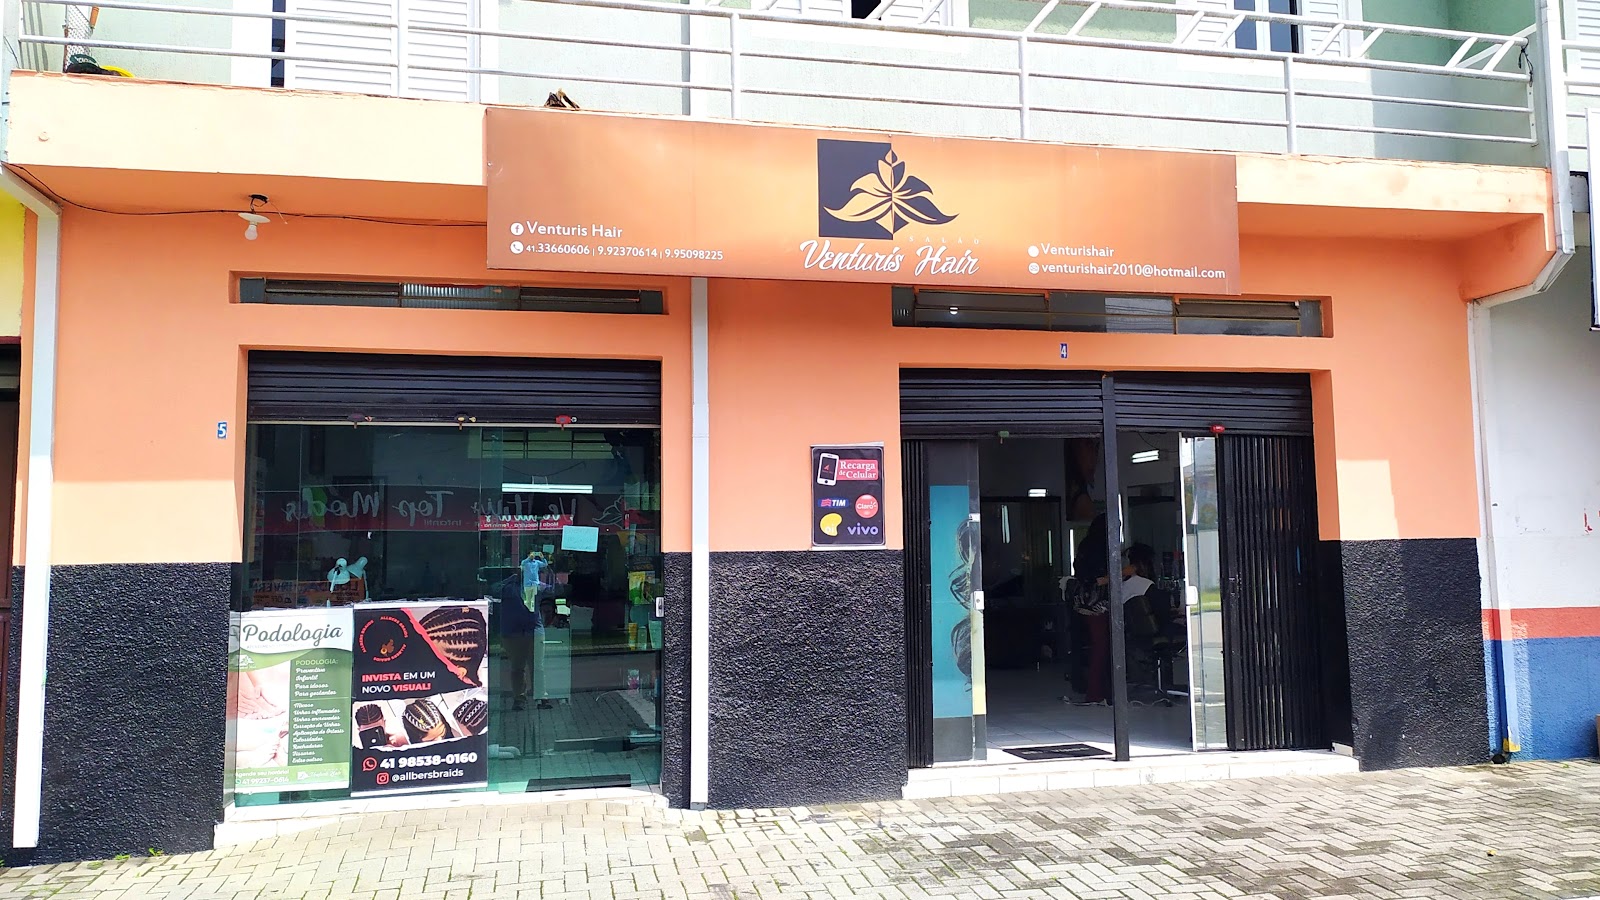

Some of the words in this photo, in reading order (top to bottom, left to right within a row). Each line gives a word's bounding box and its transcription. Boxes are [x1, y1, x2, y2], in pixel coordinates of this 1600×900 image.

[526, 221, 588, 237] Venturis
[591, 223, 623, 238] Hair
[525, 243, 590, 255] 41.33660606
[597, 246, 658, 258] 9.92370614
[664, 249, 724, 260] 9.95098225
[1041, 243, 1114, 257] Venturishair
[799, 239, 904, 272] Venturis
[914, 245, 980, 277] Hair
[1042, 263, 1225, 279] venturishair2010@hotmail.com
[840, 461, 876, 471] Recarga
[846, 469, 877, 479] Celular
[847, 522, 879, 535] vivo
[242, 623, 343, 647] Podologia
[295, 658, 339, 666] PODOLOGIA:
[362, 673, 401, 683] INVISTA
[403, 671, 418, 680] EM
[420, 671, 436, 680] UM
[362, 685, 391, 694] NOVO
[392, 682, 432, 692] VISUAL!
[380, 758, 396, 769] 41
[398, 751, 478, 768] 98538-0160
[391, 768, 464, 782] @allbersbraids
